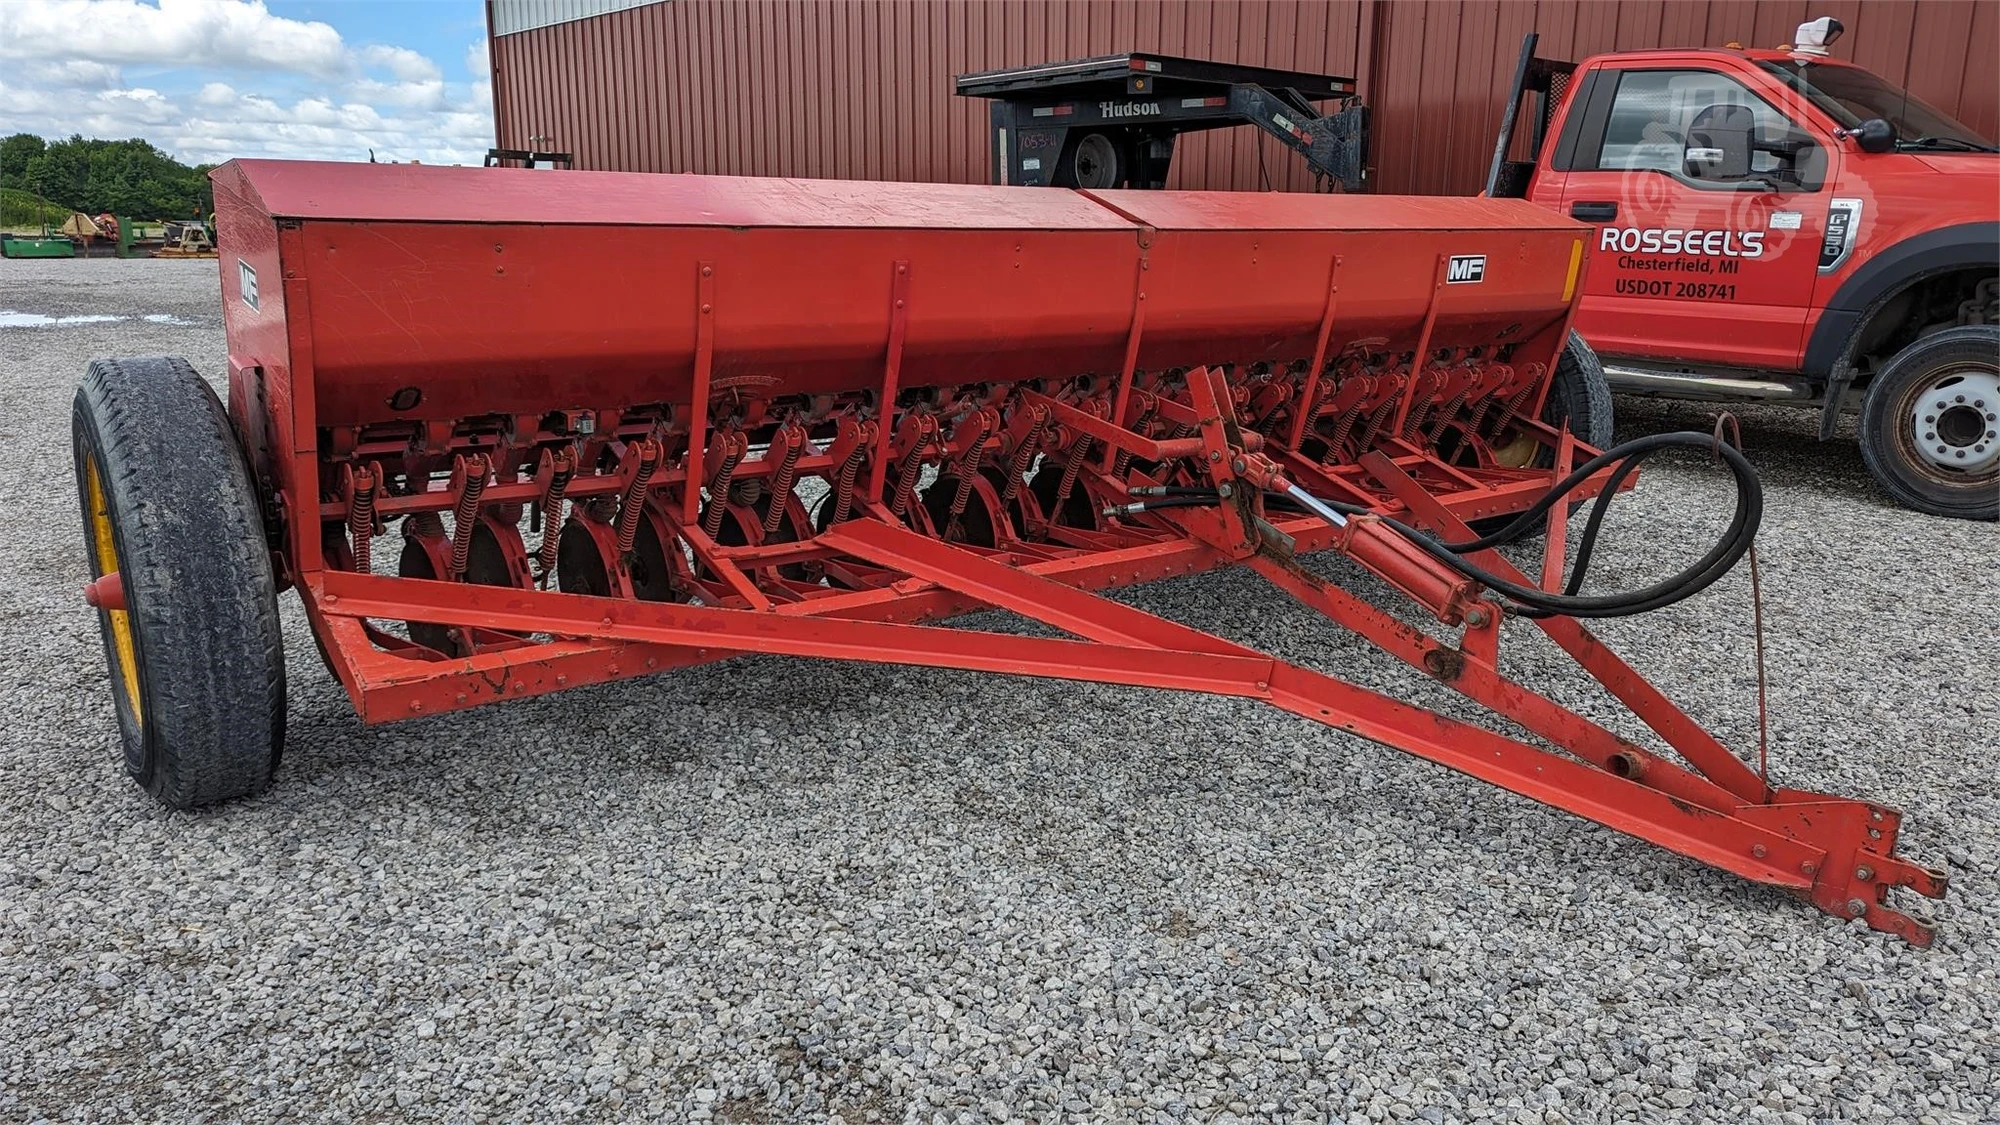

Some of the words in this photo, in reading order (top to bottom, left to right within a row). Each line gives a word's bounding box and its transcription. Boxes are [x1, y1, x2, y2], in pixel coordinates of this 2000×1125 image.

[1099, 101, 1161, 118] Hudson
[1600, 227, 1765, 257] ROSSEEL'S
[1824, 213, 1848, 256] F550
[1449, 259, 1484, 280] MF
[1618, 255, 1714, 275] Chesterfield,
[1718, 260, 1739, 274] MI
[240, 263, 258, 304] MF
[1615, 278, 1673, 296] USDOT
[1675, 282, 1736, 300] 208741
